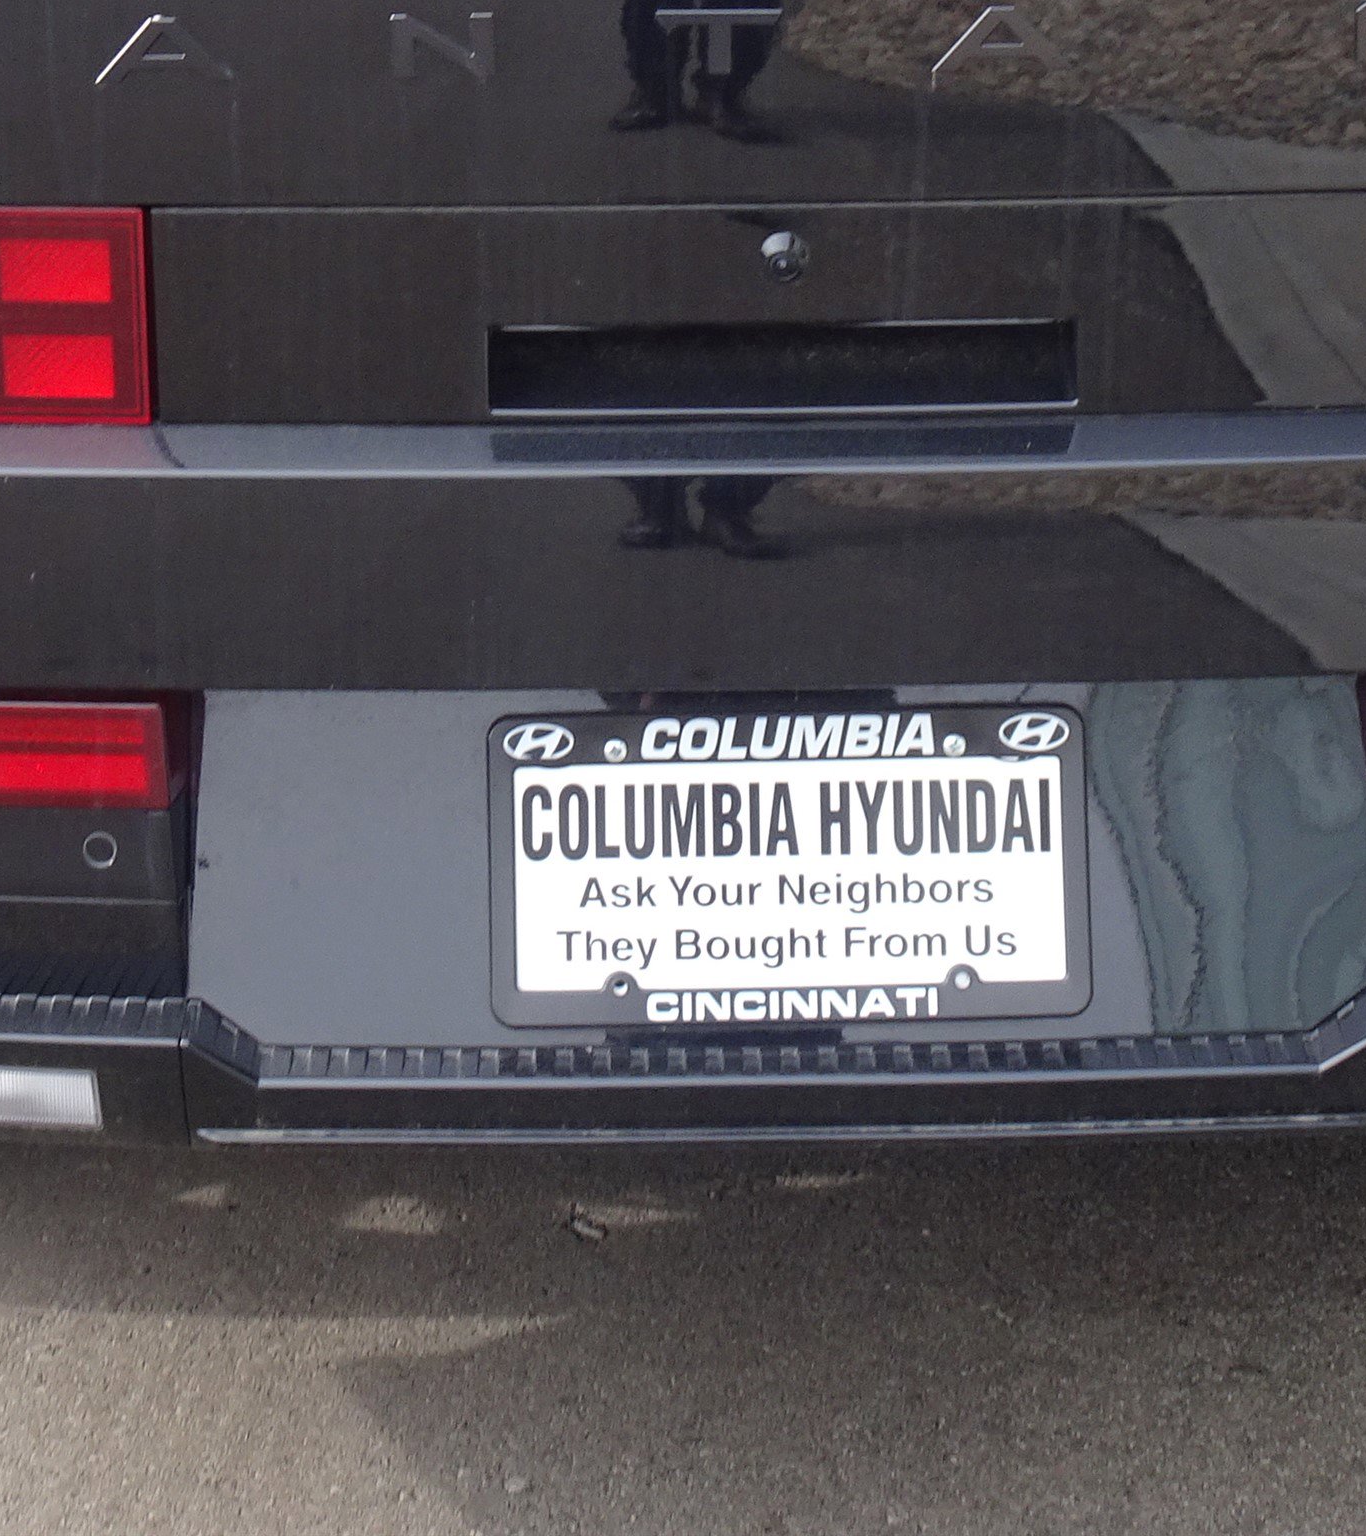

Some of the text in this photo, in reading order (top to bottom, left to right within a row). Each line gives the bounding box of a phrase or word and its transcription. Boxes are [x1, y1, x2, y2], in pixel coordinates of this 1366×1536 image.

[640, 712, 936, 761] COLUMBIA
[521, 777, 1053, 861] COLUMBIA HYUNDAI
[578, 871, 995, 914] Ask Your Neighbors
[555, 923, 1018, 970] They Bought From Us
[645, 986, 938, 1023] CINCINNATI
